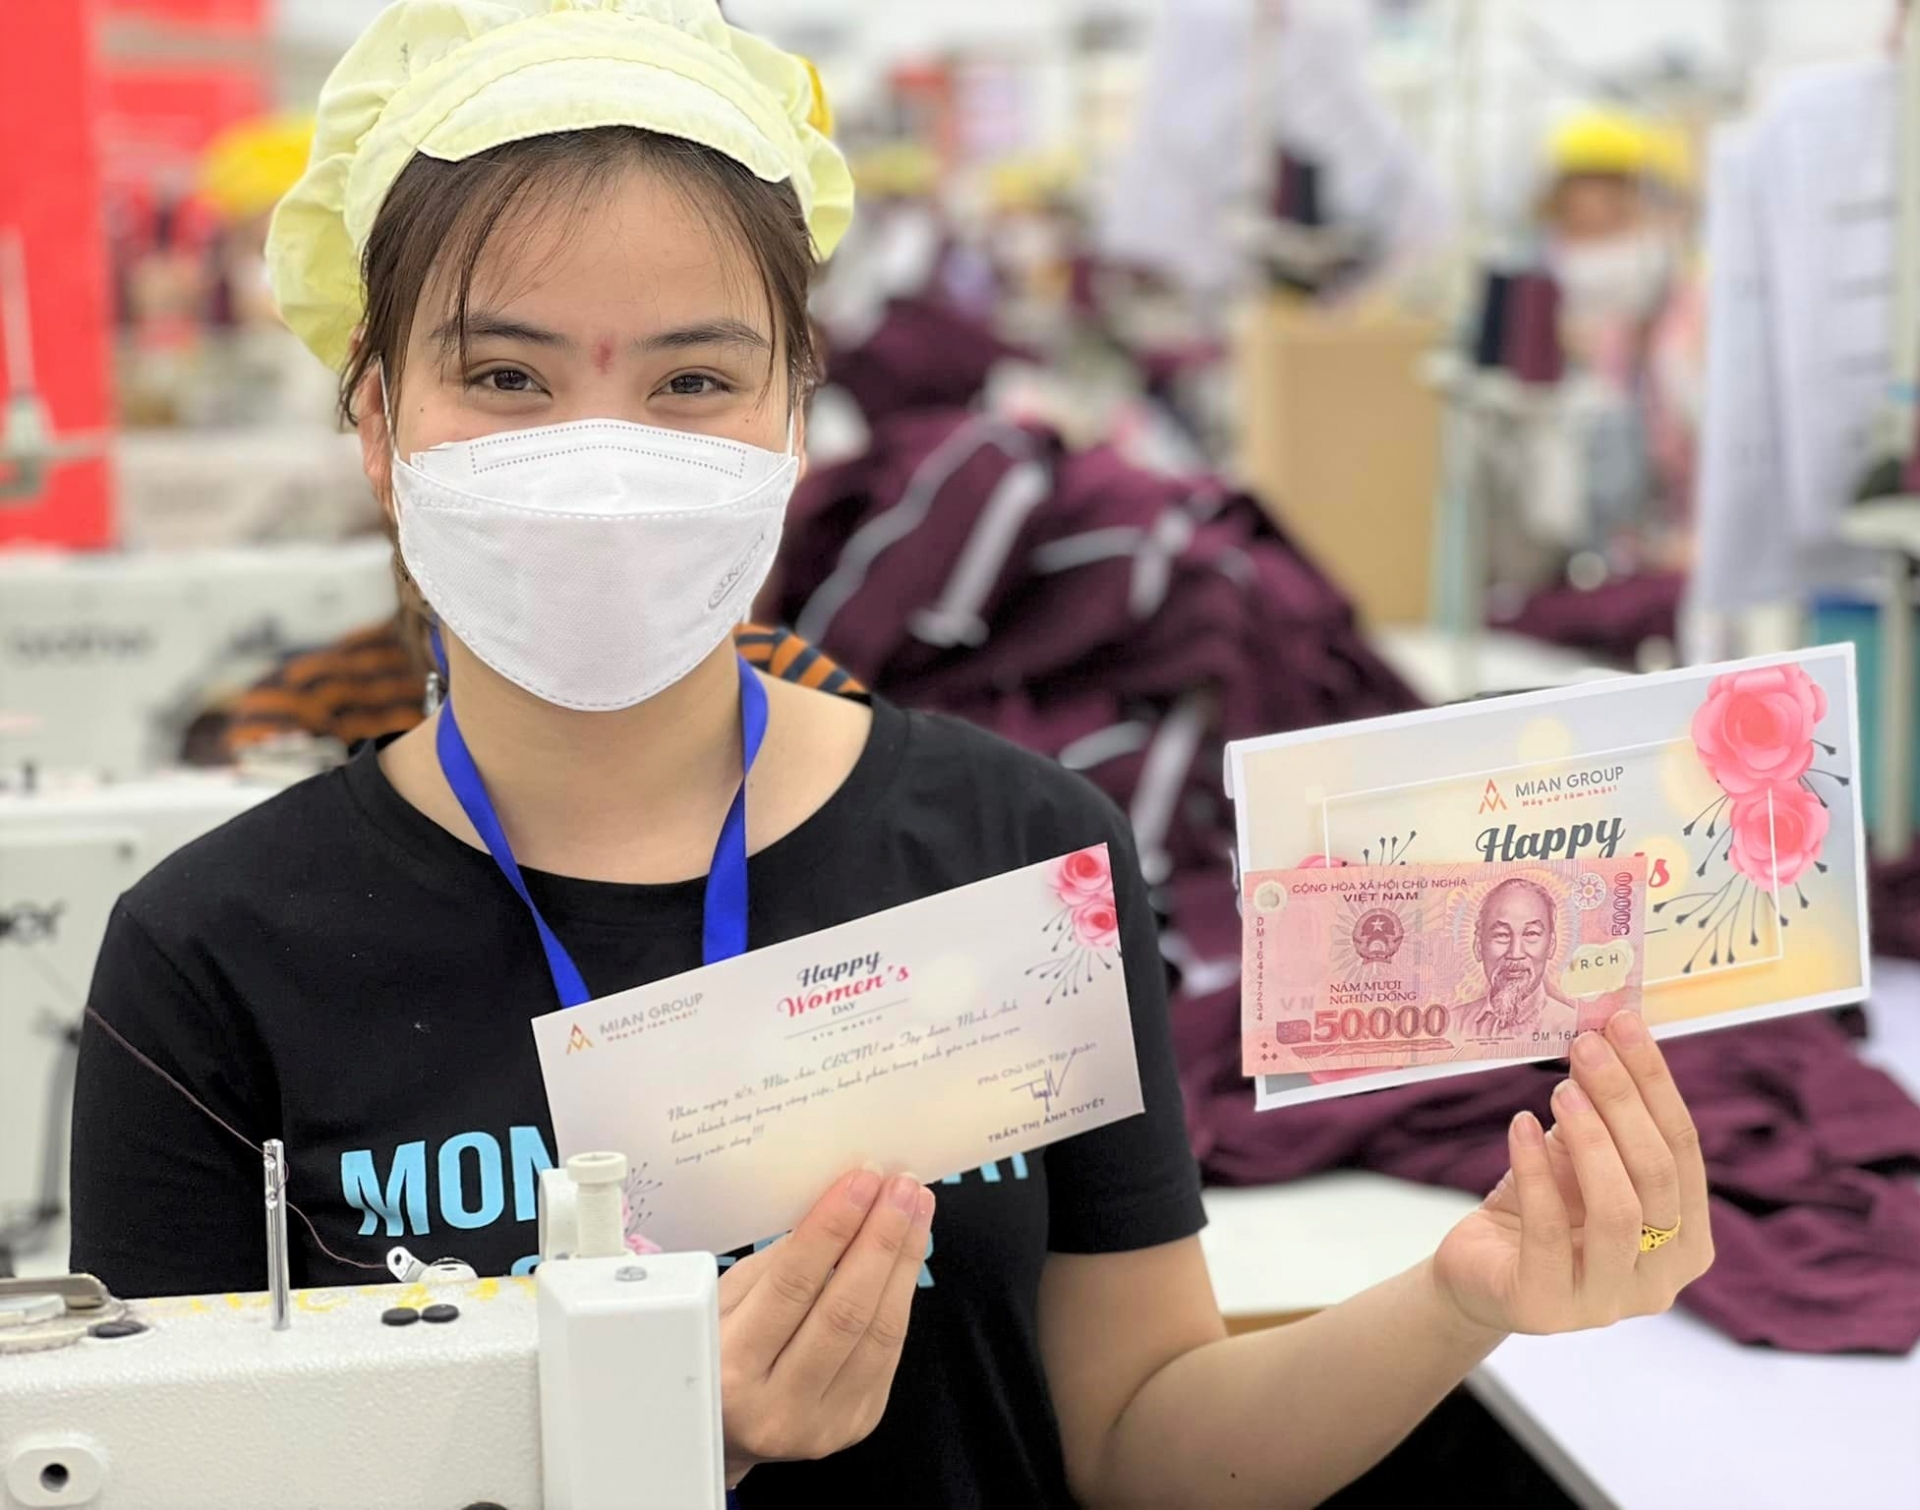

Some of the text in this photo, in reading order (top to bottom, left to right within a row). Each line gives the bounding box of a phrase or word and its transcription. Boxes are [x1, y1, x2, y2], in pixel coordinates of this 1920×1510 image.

[1515, 766, 1624, 798] MIAN GROUP
[1475, 817, 1626, 862] Happy
[1292, 876, 1468, 895] CỘNG HÒA XÃ HỘI CHỦ NGHĨA
[1342, 891, 1419, 904] VIỆT NAM
[797, 951, 882, 988] Happy
[1580, 953, 1619, 970] RCH
[777, 965, 910, 1018] Women's
[1329, 981, 1360, 993] NĂM
[600, 1011, 644, 1035] MIAN
[648, 992, 703, 1019] GROUP
[831, 1001, 855, 1016] DAY
[340, 1125, 555, 1237] MON
